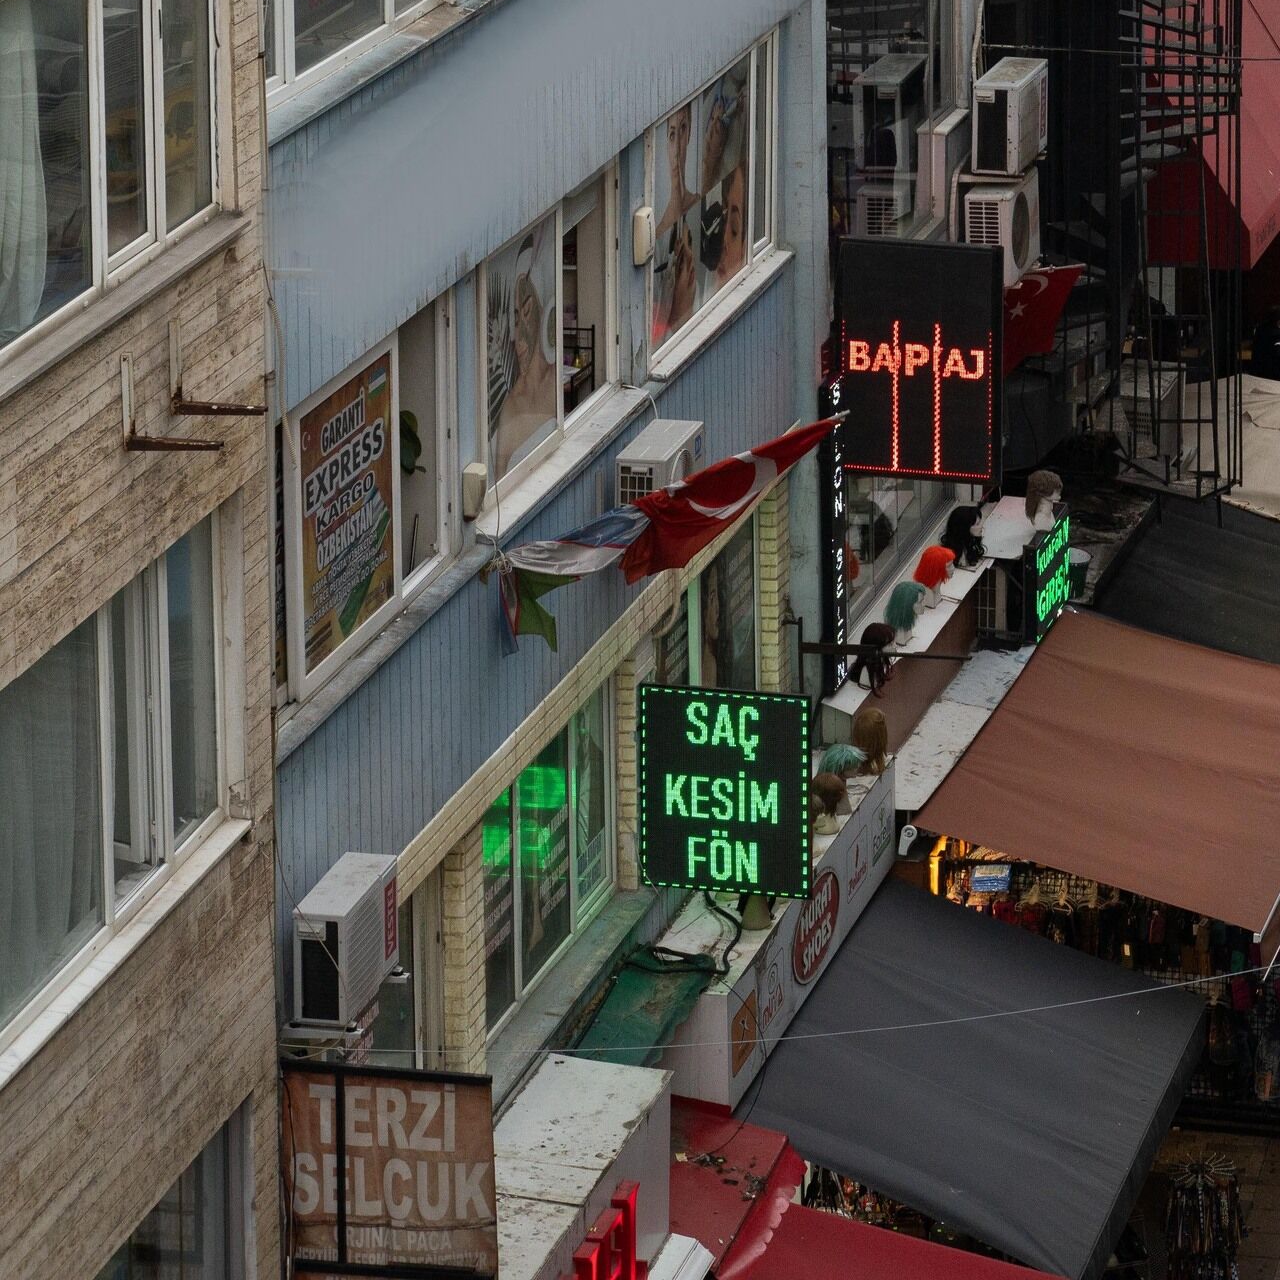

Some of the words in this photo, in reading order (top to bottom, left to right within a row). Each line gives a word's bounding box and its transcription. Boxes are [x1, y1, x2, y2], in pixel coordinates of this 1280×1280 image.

[320, 386, 366, 456] GARANTİ
[304, 418, 385, 518] EXPRESS
[316, 471, 374, 536] KARGO
[316, 496, 375, 571] ÖZBEKİSTAN
[686, 701, 759, 761] SAÇ
[665, 771, 778, 824] KESİM
[687, 829, 758, 884] FÖN
[800, 872, 834, 942] MURAT
[802, 911, 833, 974] SHOES
[308, 1083, 456, 1153] TERZİ
[290, 1151, 493, 1228] SELÇUK
